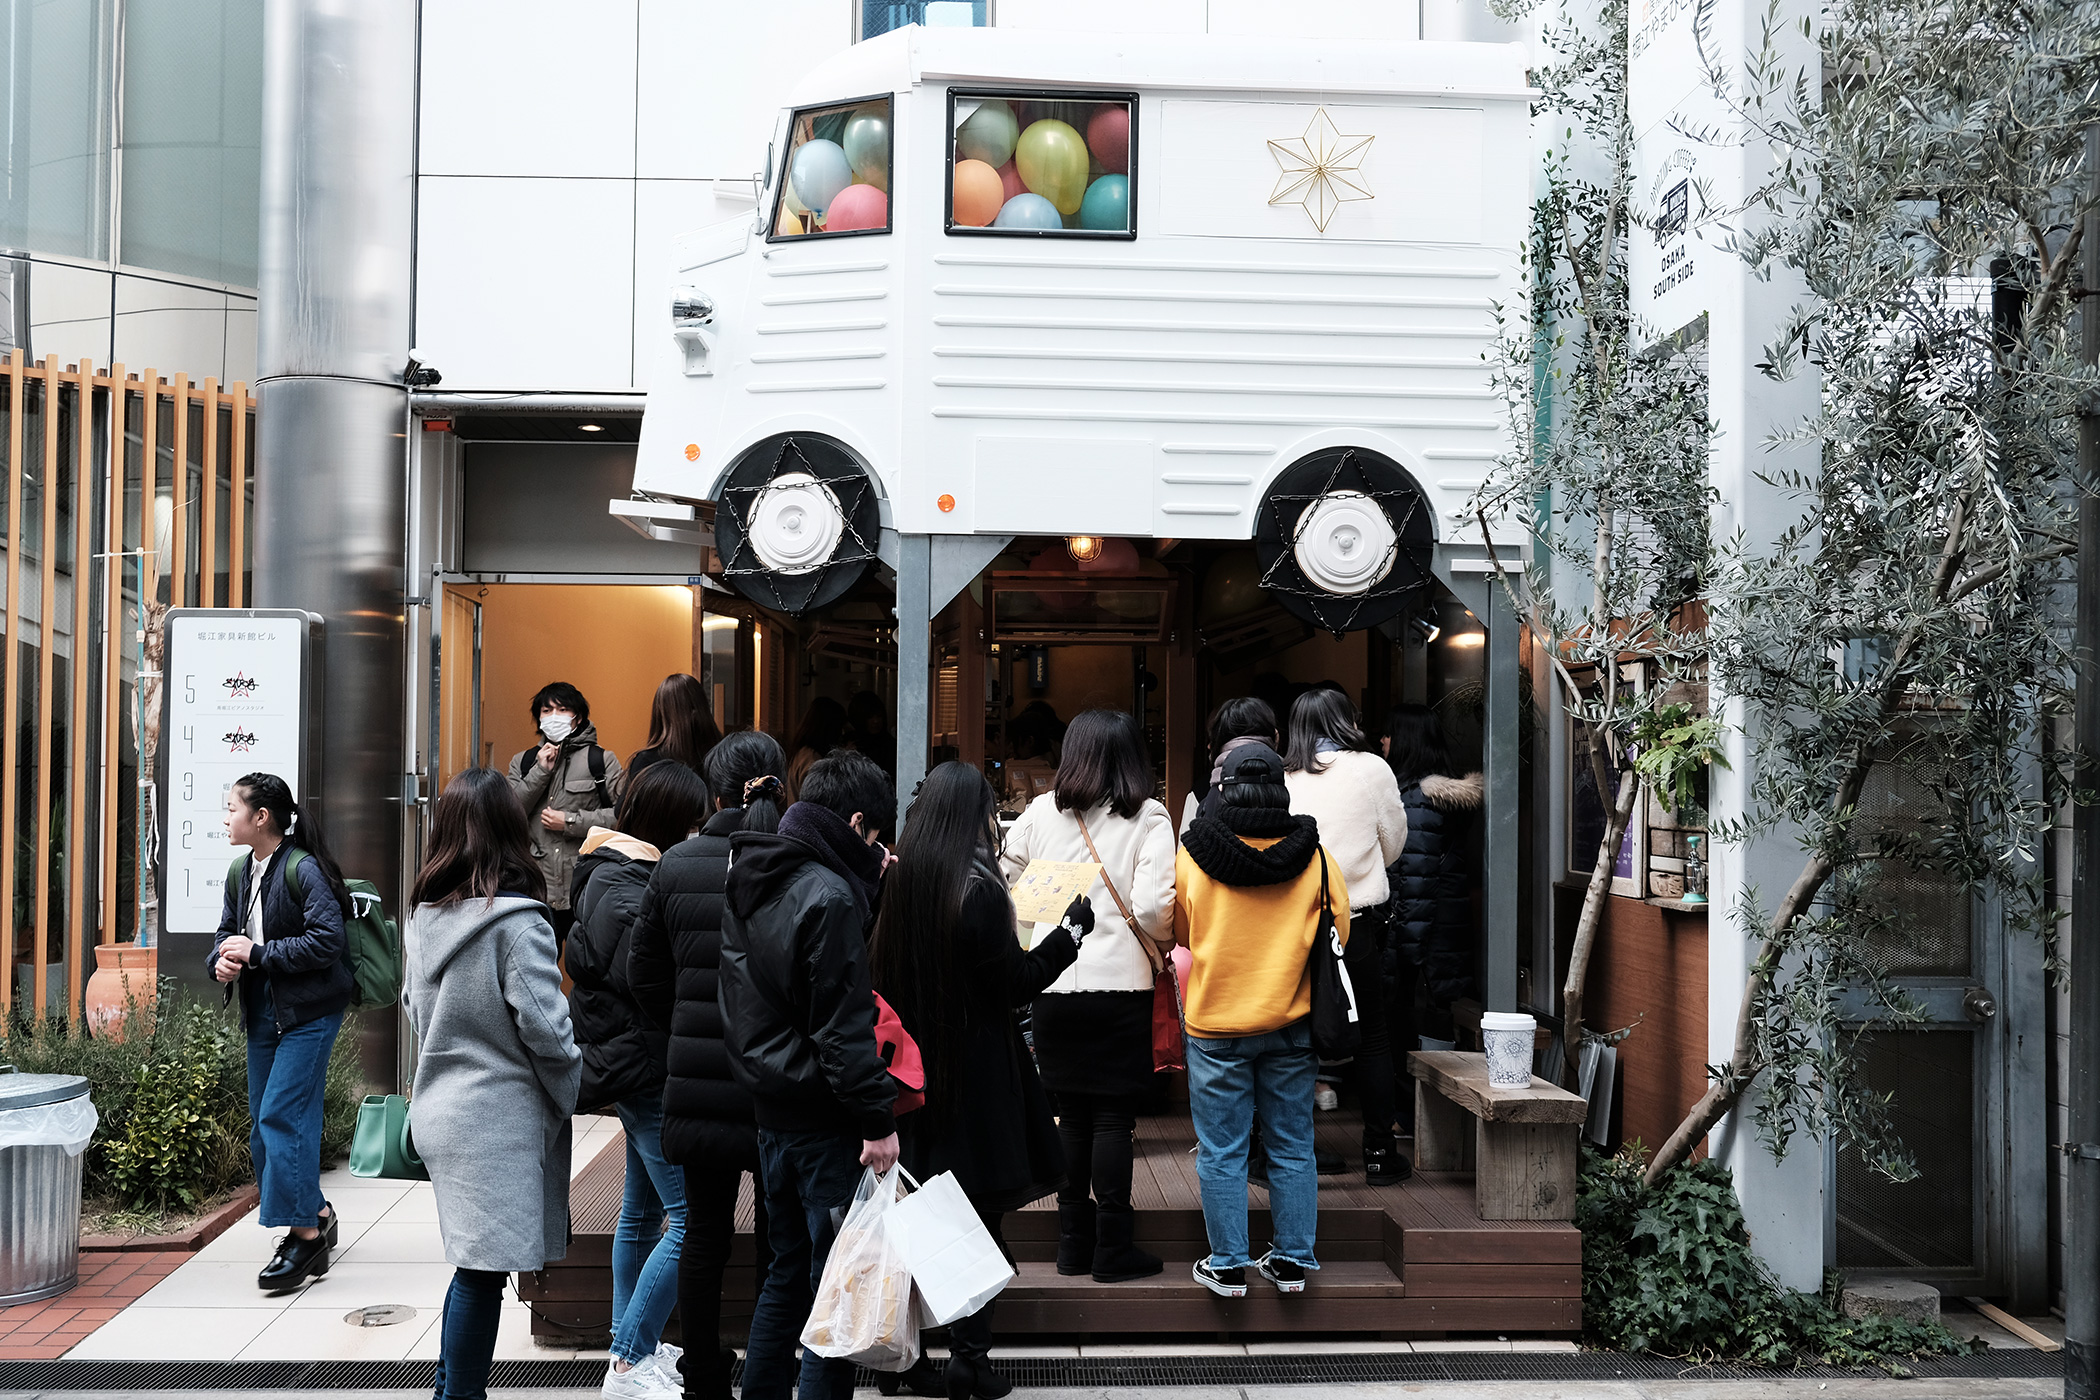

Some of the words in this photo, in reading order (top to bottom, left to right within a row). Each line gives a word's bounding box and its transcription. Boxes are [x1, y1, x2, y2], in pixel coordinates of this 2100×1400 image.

[1661, 244, 1686, 273] OSAKA
[1653, 272, 1676, 300] SOUTH
[1677, 260, 1694, 284] SIDE
[185, 674, 196, 704] 5
[183, 725, 194, 754] 4
[183, 772, 194, 801] 3
[182, 820, 193, 849] 2
[184, 869, 190, 897] 1
